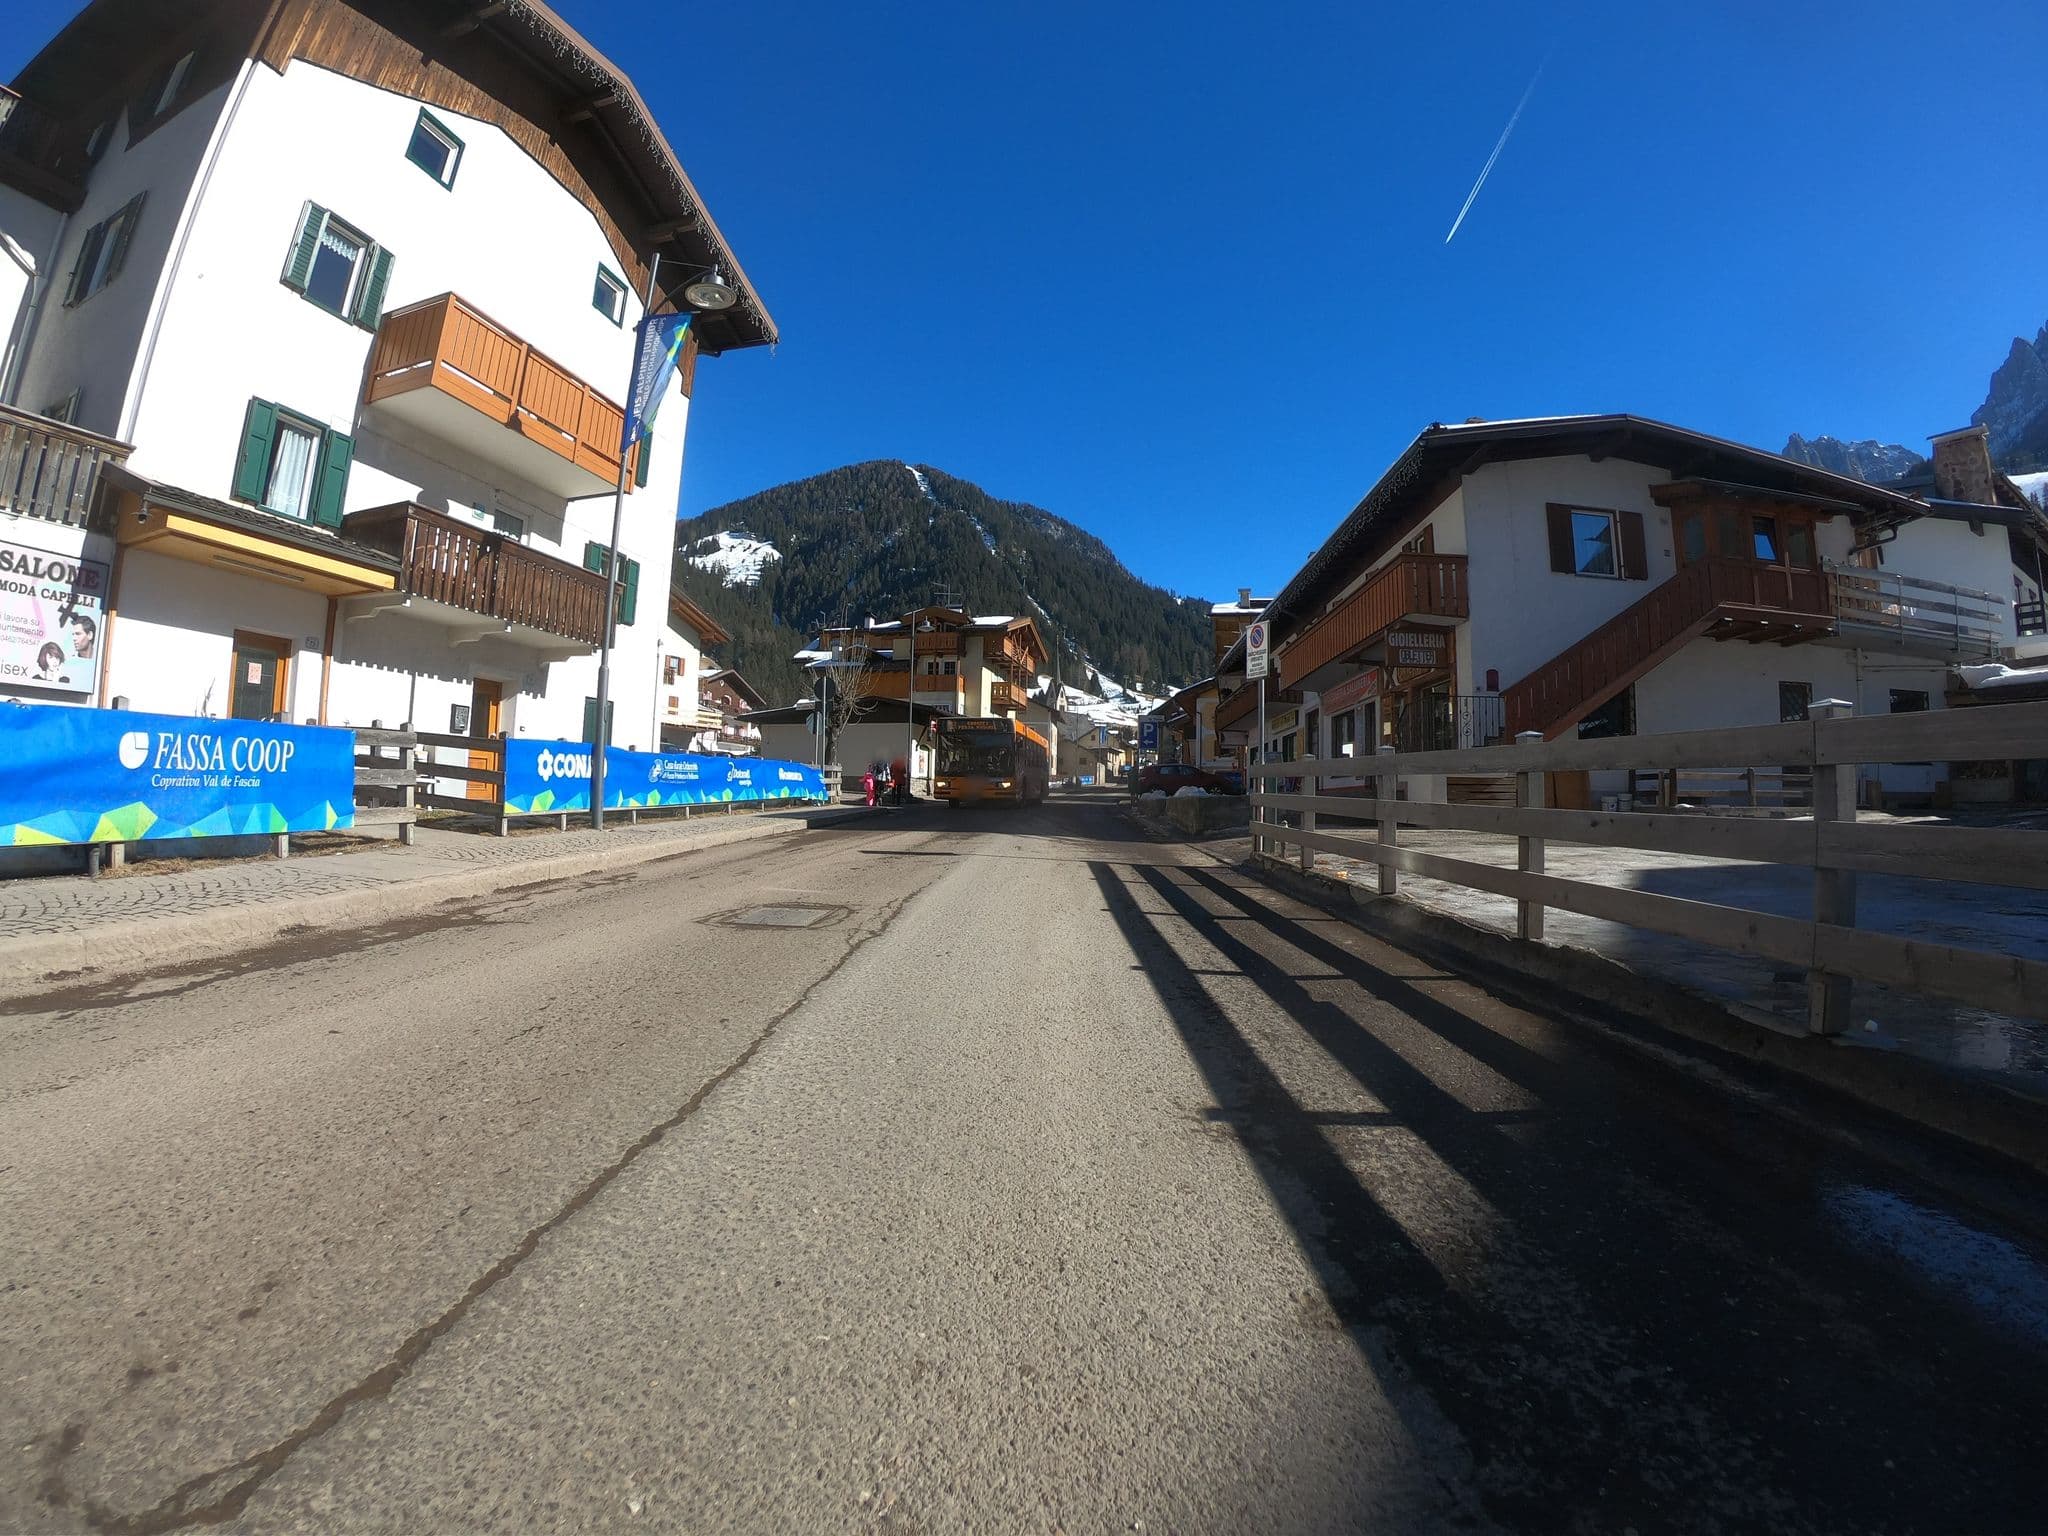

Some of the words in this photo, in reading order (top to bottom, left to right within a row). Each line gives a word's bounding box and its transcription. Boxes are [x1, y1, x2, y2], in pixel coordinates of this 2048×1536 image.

[636, 353, 650, 394] ALPINE
[643, 319, 658, 352] JUNIOR
[0, 550, 100, 590] SALONE
[0, 579, 36, 597] MODA
[41, 588, 95, 608] CAPELLI
[1388, 632, 1446, 649] GIOIELLERIA
[1143, 723, 1154, 737] P
[153, 732, 226, 772] FASSA
[231, 736, 295, 773] COOP
[553, 753, 608, 778] CON
[151, 773, 201, 790] Coprativa
[203, 774, 219, 788] Val
[220, 775, 232, 788] de
[233, 775, 261, 788] Fascia
